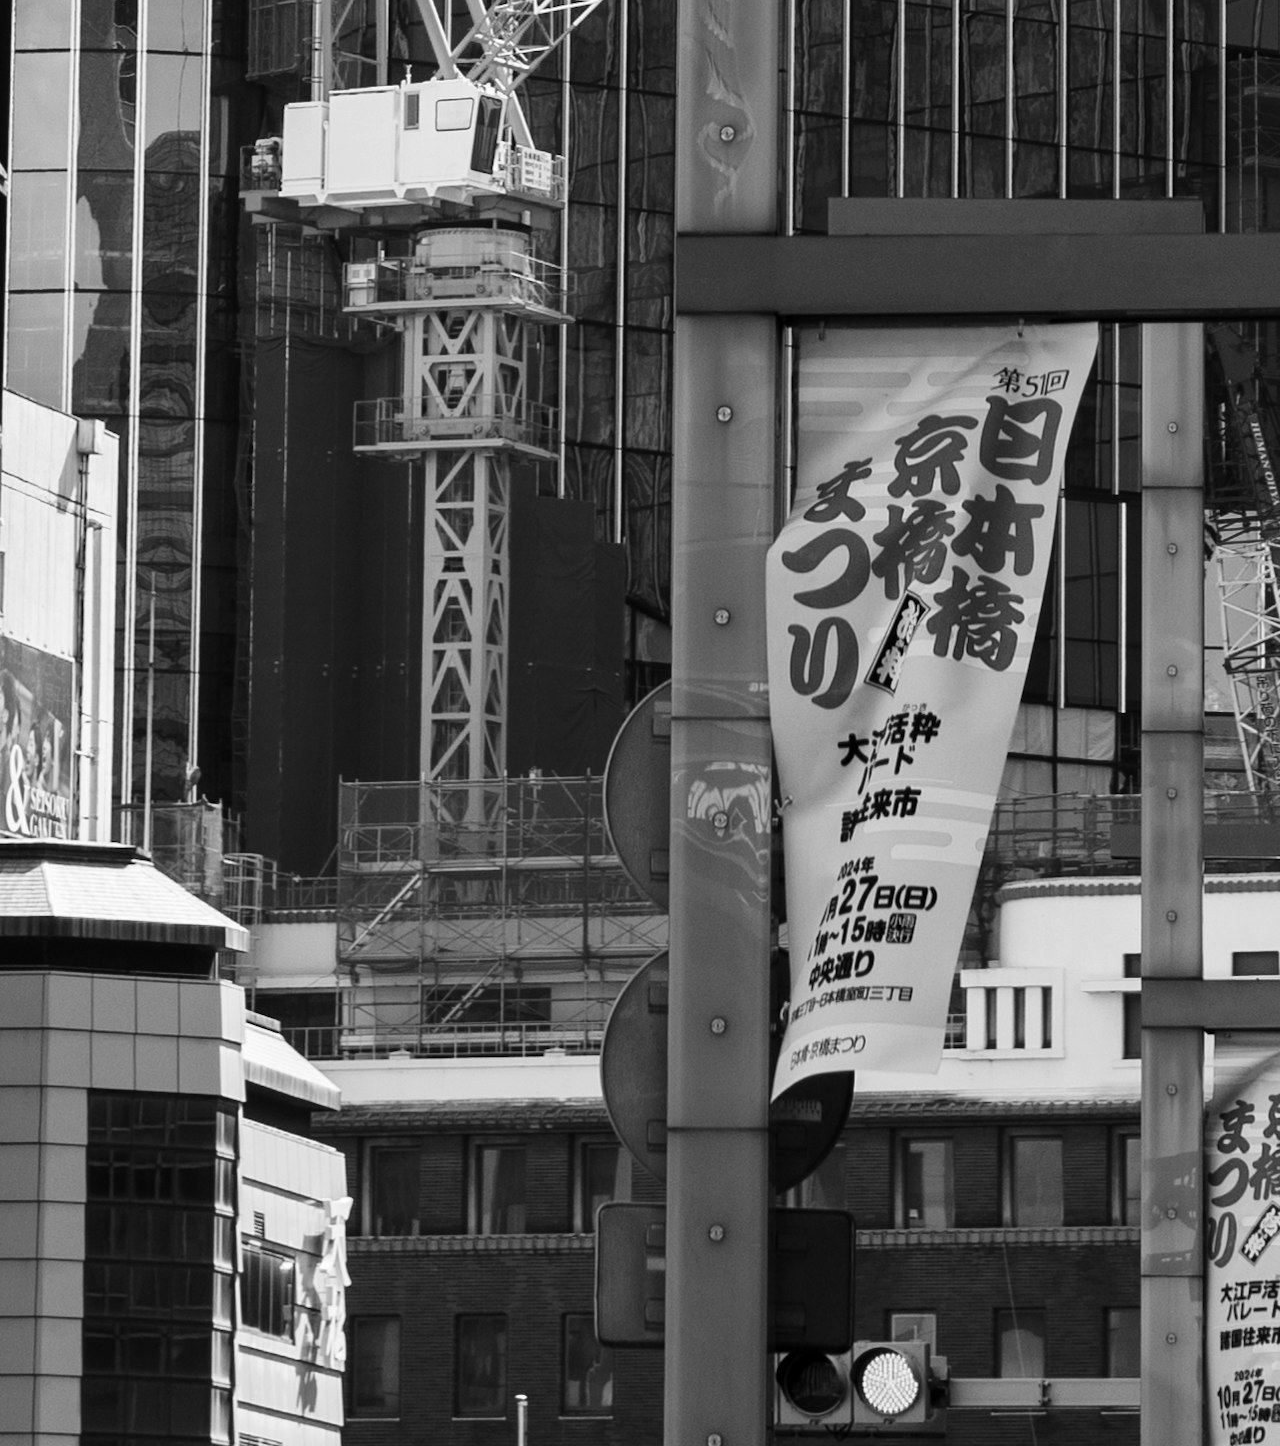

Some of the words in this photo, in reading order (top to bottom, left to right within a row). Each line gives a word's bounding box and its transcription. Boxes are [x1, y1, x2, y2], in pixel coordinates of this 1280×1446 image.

[990, 366, 1070, 398] 第51回
[781, 458, 874, 710] まつり
[871, 413, 979, 601] 京橋
[926, 395, 1063, 672] 日本橋
[1208, 1099, 1255, 1268] まつり
